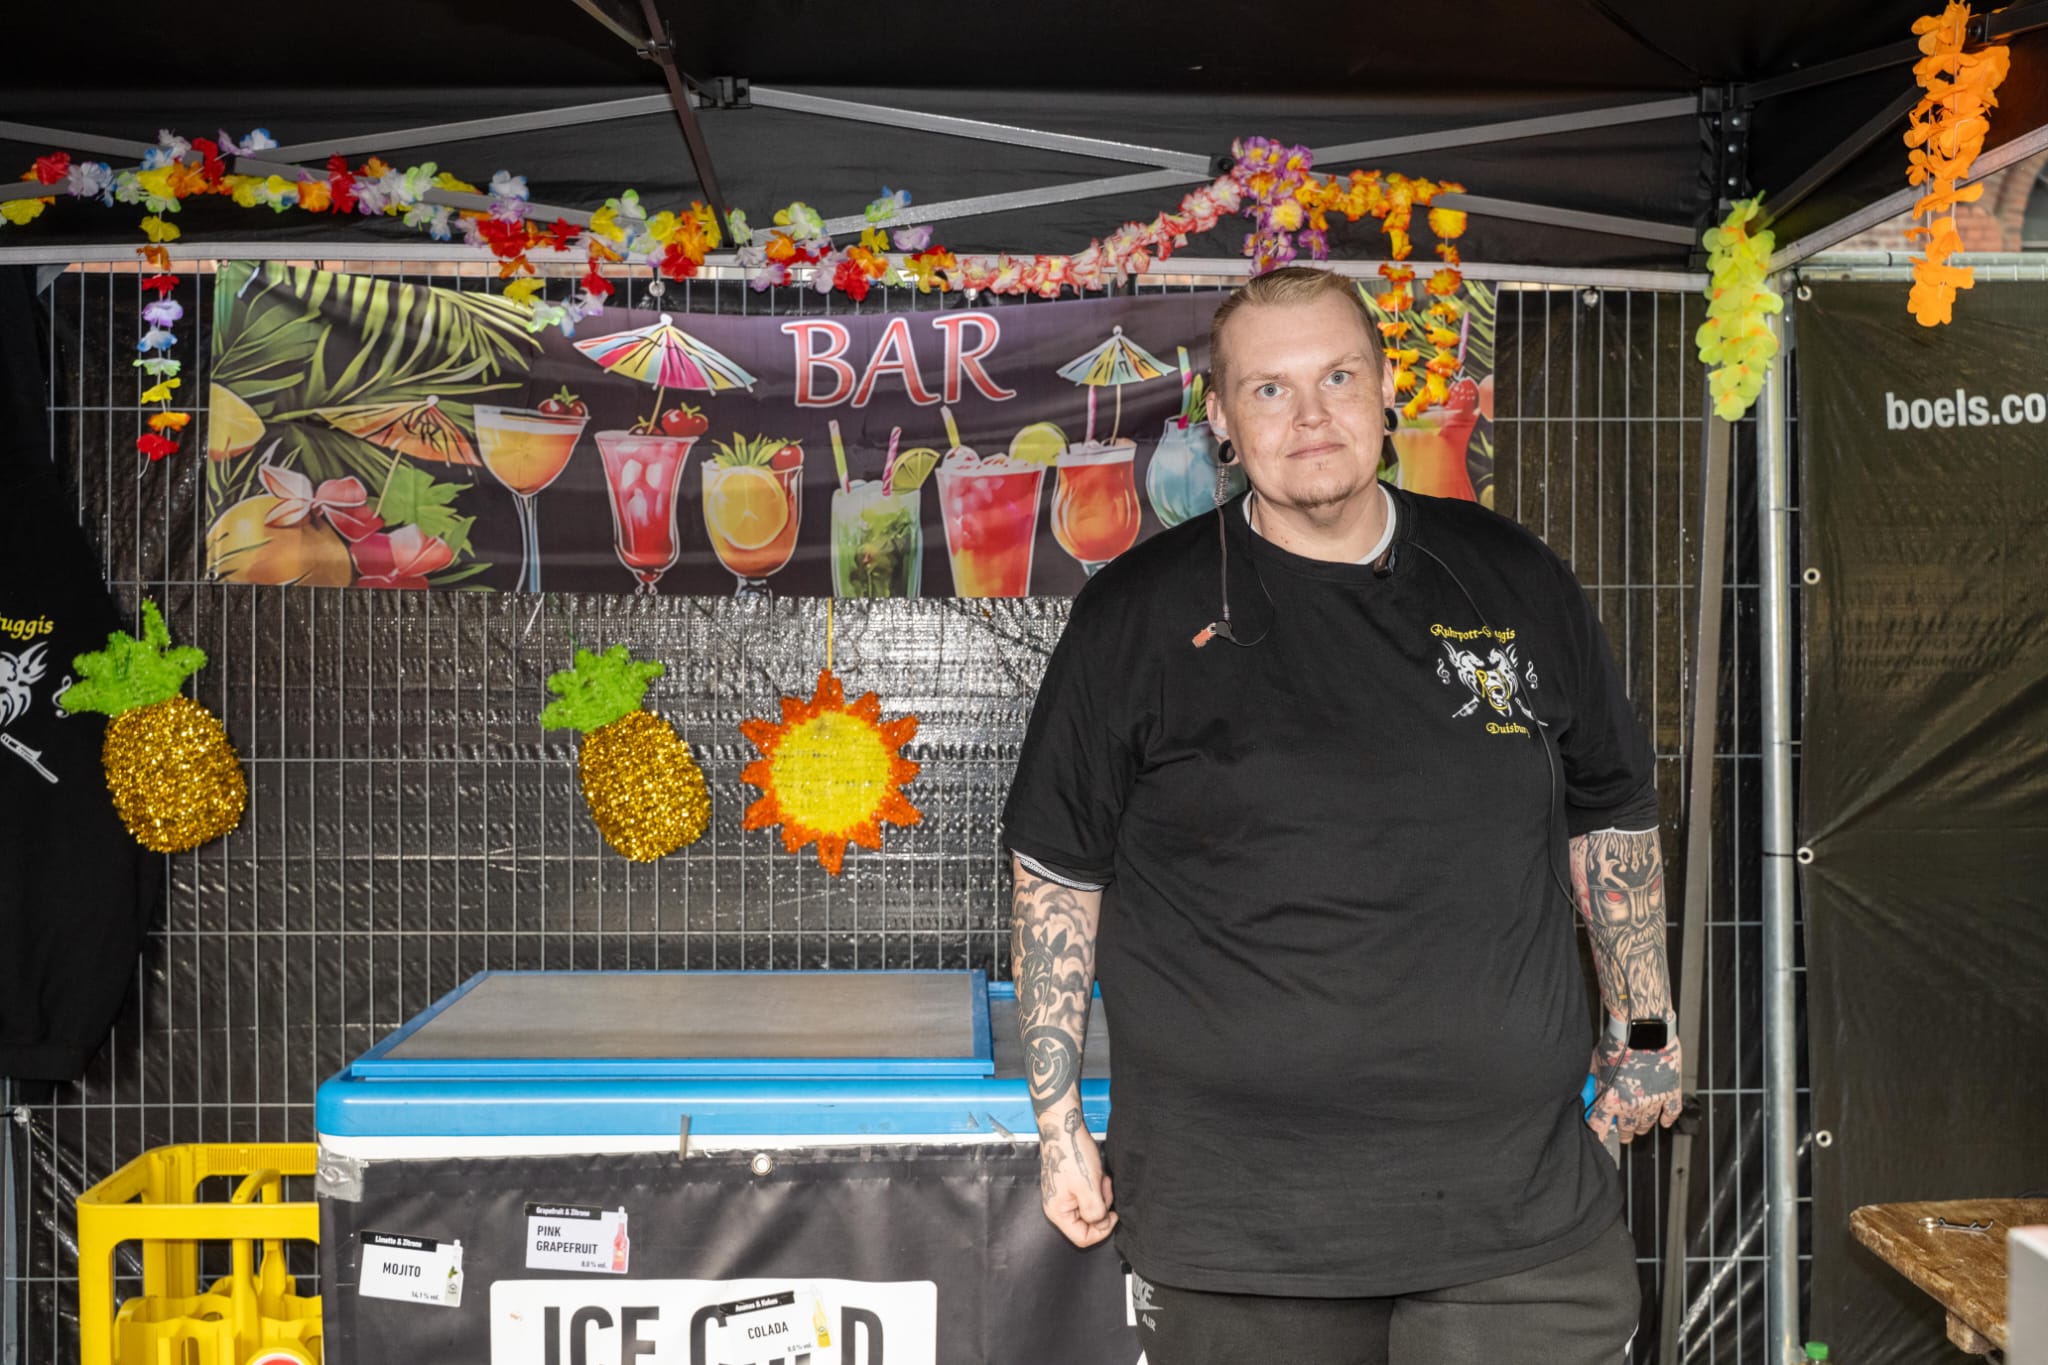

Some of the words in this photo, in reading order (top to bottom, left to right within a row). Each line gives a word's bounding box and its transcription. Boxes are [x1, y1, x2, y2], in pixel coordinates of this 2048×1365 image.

[781, 312, 1017, 408] BAR
[1885, 388, 2048, 430] boels.co
[0, 612, 54, 640] uggis
[1486, 722, 1531, 739] Duisbur
[537, 1225, 561, 1237] PINK
[536, 1240, 598, 1255] GRAPEFRUIT
[382, 1262, 421, 1277] MOJITO
[747, 1321, 789, 1339] COLADA
[1142, 1313, 1156, 1332] AIR
[544, 1305, 660, 1365] ICE
[690, 1304, 884, 1365] CD
